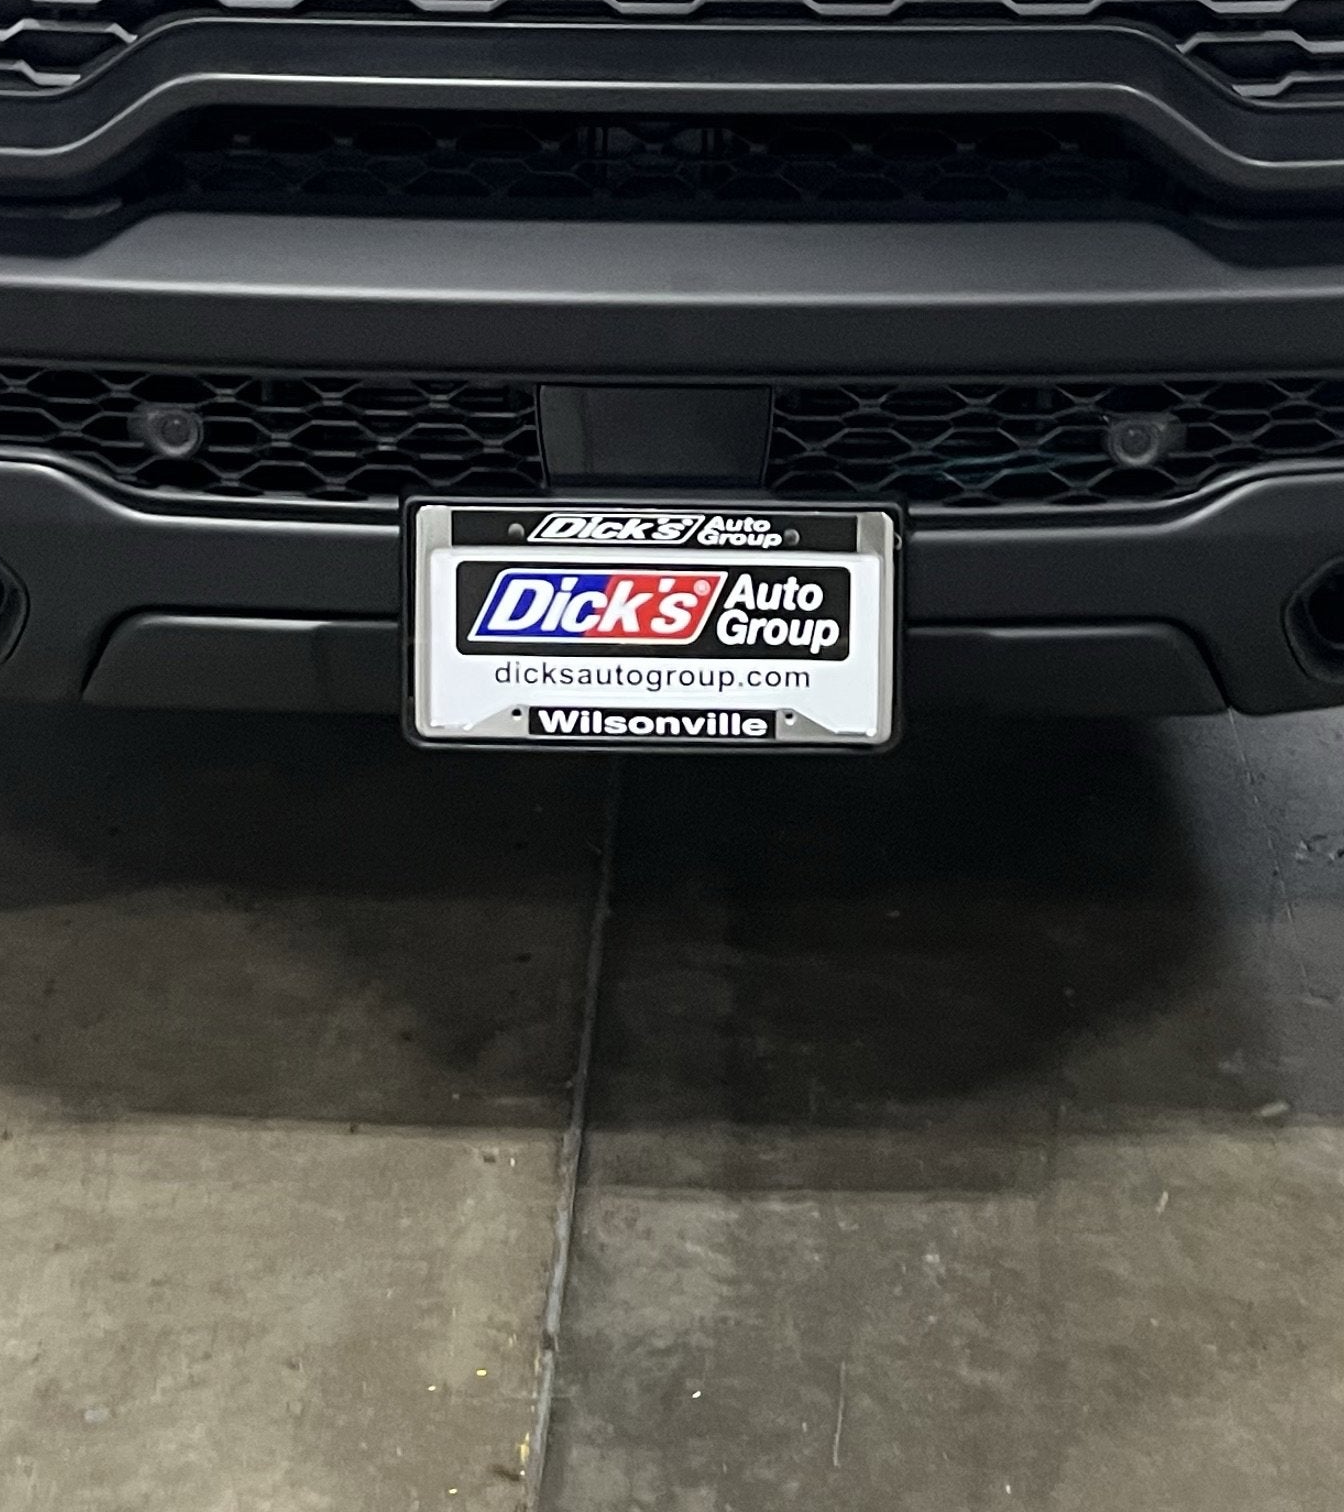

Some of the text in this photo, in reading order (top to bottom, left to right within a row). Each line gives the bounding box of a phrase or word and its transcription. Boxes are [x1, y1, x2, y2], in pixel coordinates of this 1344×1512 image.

[540, 515, 772, 540] Dick's Auto
[696, 530, 783, 549] Group
[487, 573, 824, 636] Dick's Auto
[716, 609, 840, 655] Group
[494, 662, 811, 692] dicksautogroup.com
[537, 709, 769, 738] Wilsonville
